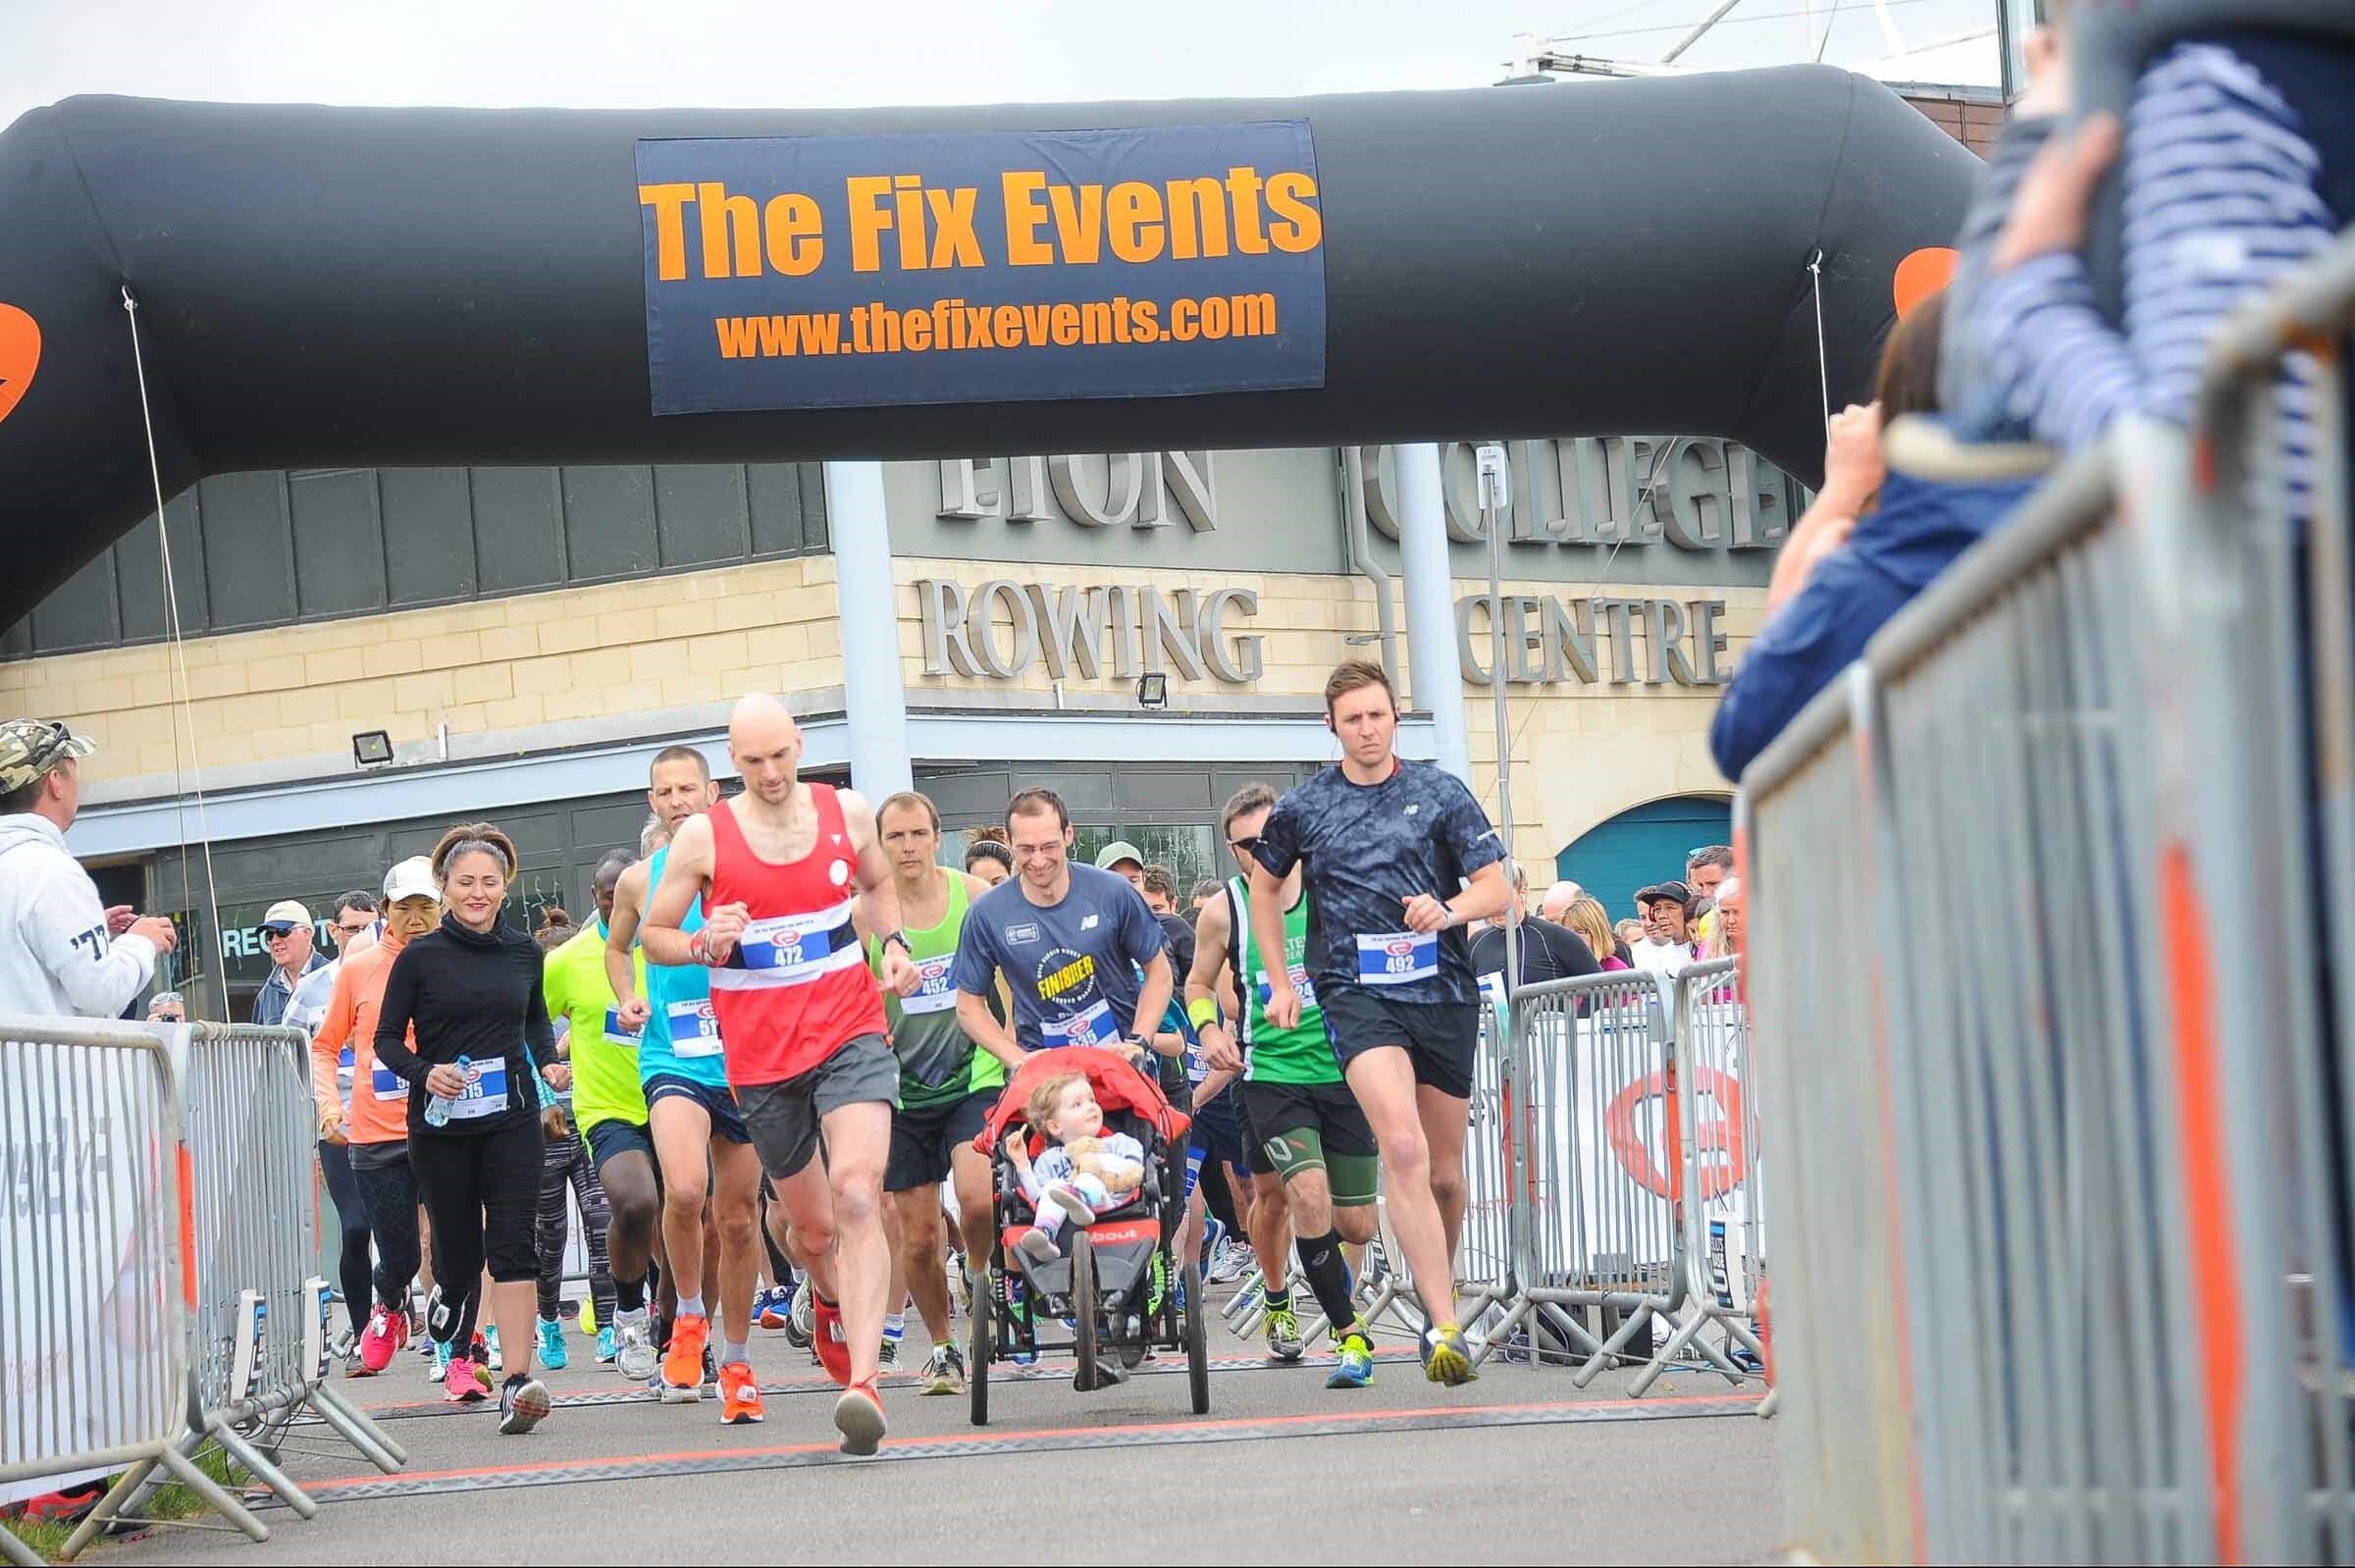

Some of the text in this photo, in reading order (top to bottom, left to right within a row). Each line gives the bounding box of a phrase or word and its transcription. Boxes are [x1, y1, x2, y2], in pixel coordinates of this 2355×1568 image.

[638, 165, 1323, 282] The Fix Events
[714, 291, 1277, 360] www.thefixevents.com
[912, 577, 1734, 685] ROWING CENTRE
[774, 944, 805, 967] 472
[1385, 954, 1416, 973] 492
[921, 975, 950, 996] 452
